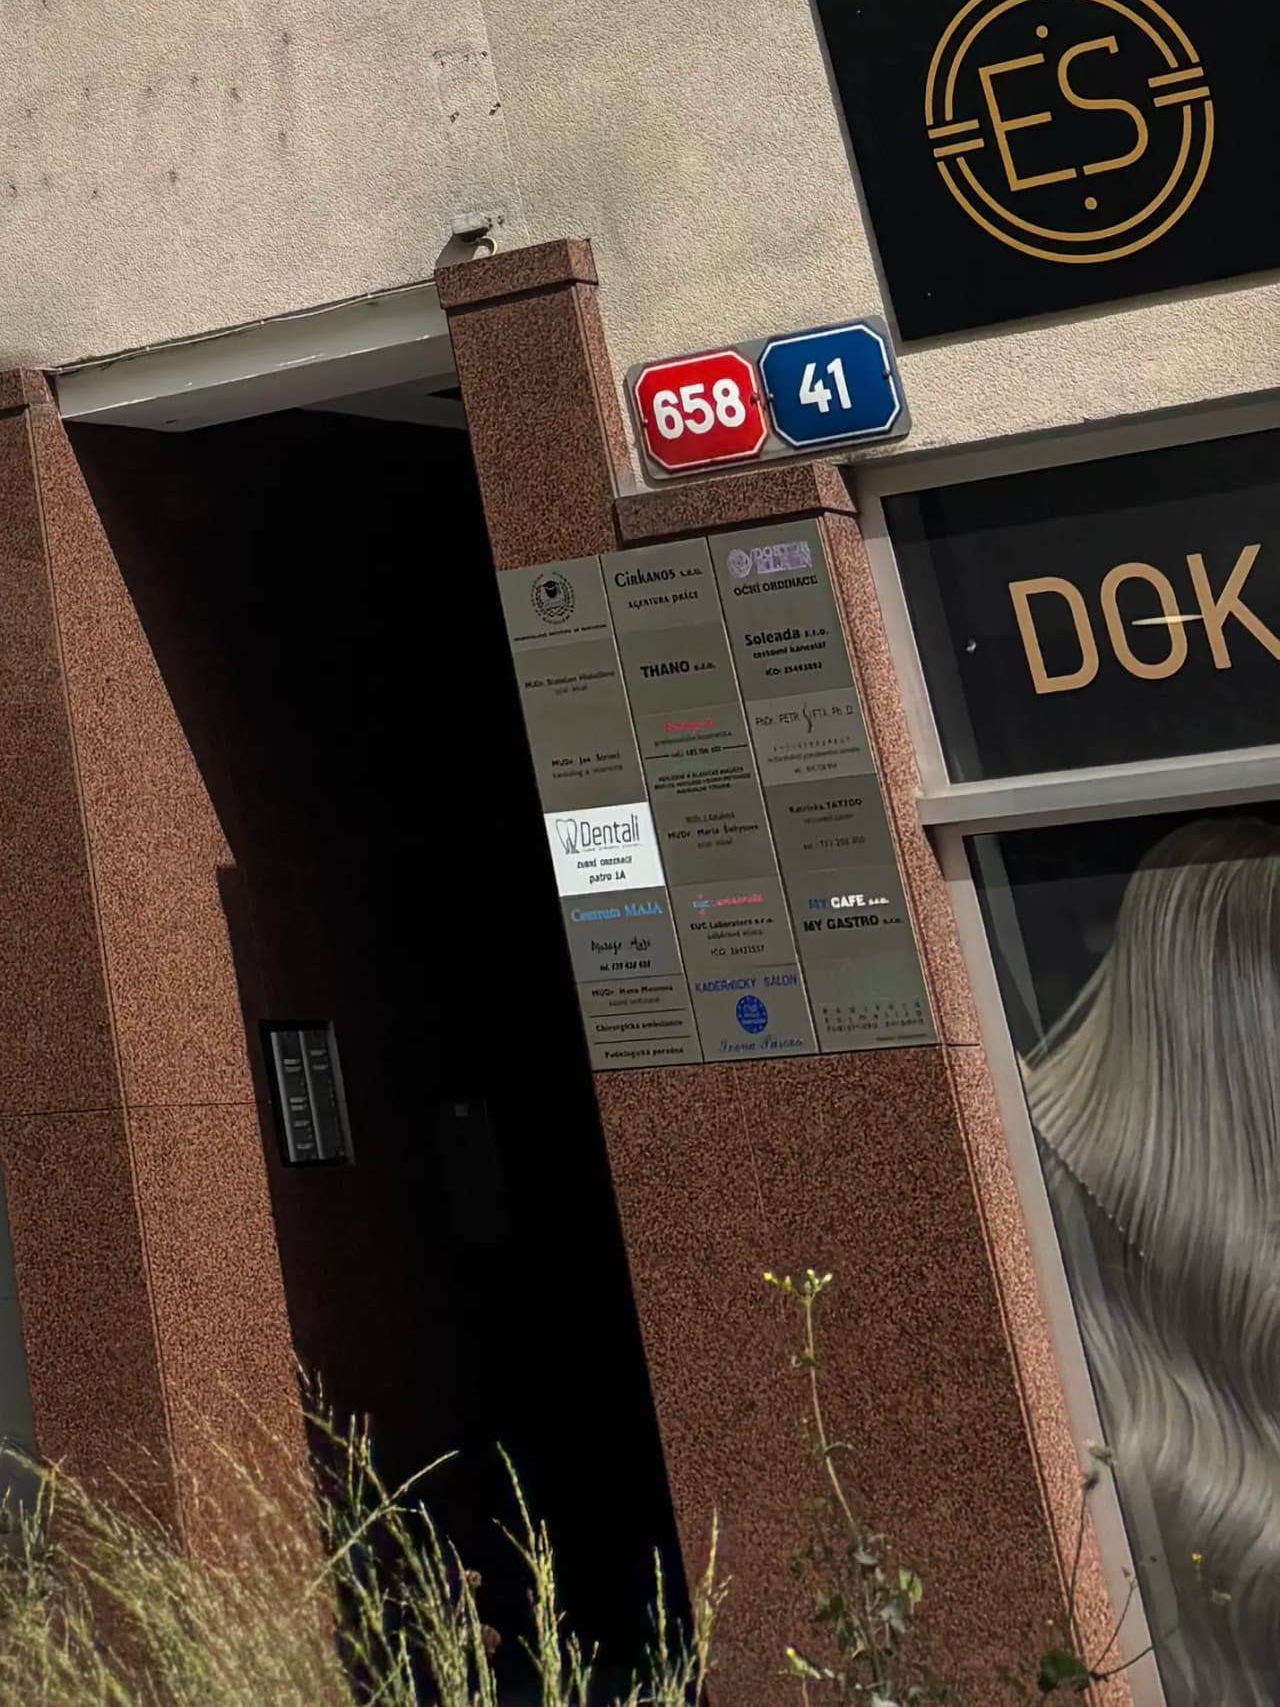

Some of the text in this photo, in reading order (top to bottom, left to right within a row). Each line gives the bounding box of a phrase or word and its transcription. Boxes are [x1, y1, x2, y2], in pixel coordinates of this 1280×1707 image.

[977, 35, 1149, 193] ES
[652, 357, 851, 441] 658 41
[1008, 543, 1280, 694] DOK
[744, 629, 800, 646] Soleada
[640, 661, 690, 678] THANO
[580, 813, 640, 848] Dentali
[589, 873, 612, 885] patro
[831, 894, 866, 908] CAFE
[804, 920, 822, 931] MY
[827, 915, 879, 930] GASTRO
